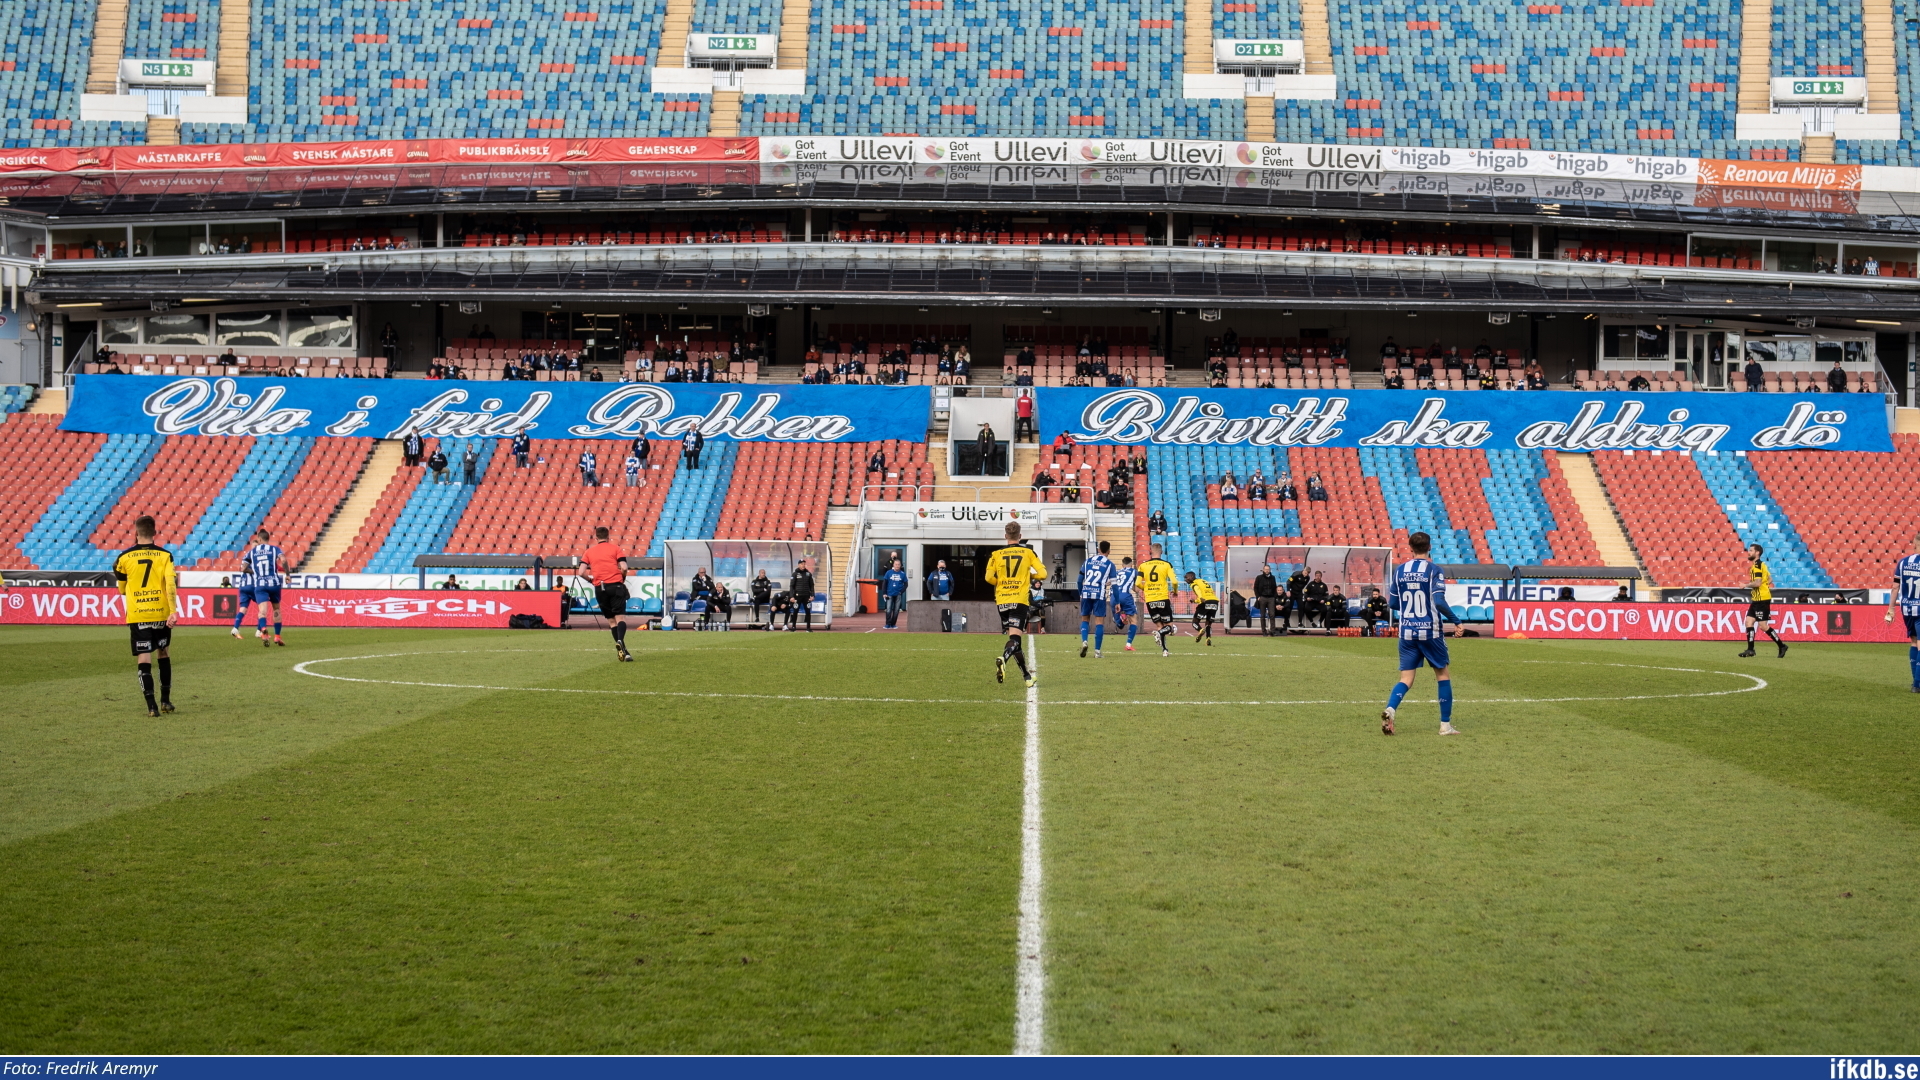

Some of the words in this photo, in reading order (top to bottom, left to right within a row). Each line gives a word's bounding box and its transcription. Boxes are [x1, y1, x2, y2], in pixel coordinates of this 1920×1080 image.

[710, 39, 725, 48] N2
[143, 65, 160, 75] N5
[292, 149, 338, 160] SVENSK
[341, 146, 394, 159] MÄSTARE
[459, 143, 550, 156] PUBLIKBRÄNSLE
[628, 145, 698, 155] GEMENSKAP
[795, 140, 815, 150] Got
[840, 139, 914, 161] Ullevi
[949, 141, 969, 151] Got
[994, 141, 1068, 162] Ullevi
[1105, 141, 1125, 152] Got
[1150, 141, 1223, 164] Ullevi
[1262, 146, 1282, 156] Got
[137, 151, 222, 164] MÄSTARKAFFE
[796, 150, 827, 160] Event
[950, 151, 981, 161] Event
[1106, 152, 1137, 162] Event
[1262, 156, 1294, 167] Event
[1307, 146, 1381, 170] Ullevi
[1399, 149, 1451, 170] higab
[1477, 150, 1528, 172] higab
[1556, 153, 1608, 176] higab
[1634, 157, 1687, 179] higab
[1723, 164, 1789, 184] Renova
[1791, 166, 1836, 189] Miljö
[143, 377, 312, 437] Vila
[325, 395, 378, 436] i
[385, 388, 552, 439] frid
[1070, 388, 1349, 445] Blåvitt
[1358, 397, 1493, 447] ska
[1515, 400, 1730, 450] aldrig
[1750, 401, 1846, 448] dö
[951, 506, 1003, 521] Ullevi
[138, 558, 153, 588] 7
[257, 560, 269, 576] 17
[1002, 555, 1024, 578] 17
[1149, 565, 1158, 582] 6
[1084, 569, 1102, 587] 22
[1906, 577, 1920, 599] 11
[32, 593, 205, 618] WORKAR
[300, 596, 374, 606] ULTIMATE
[300, 598, 496, 615] STRETCH
[1402, 590, 1428, 618] 20
